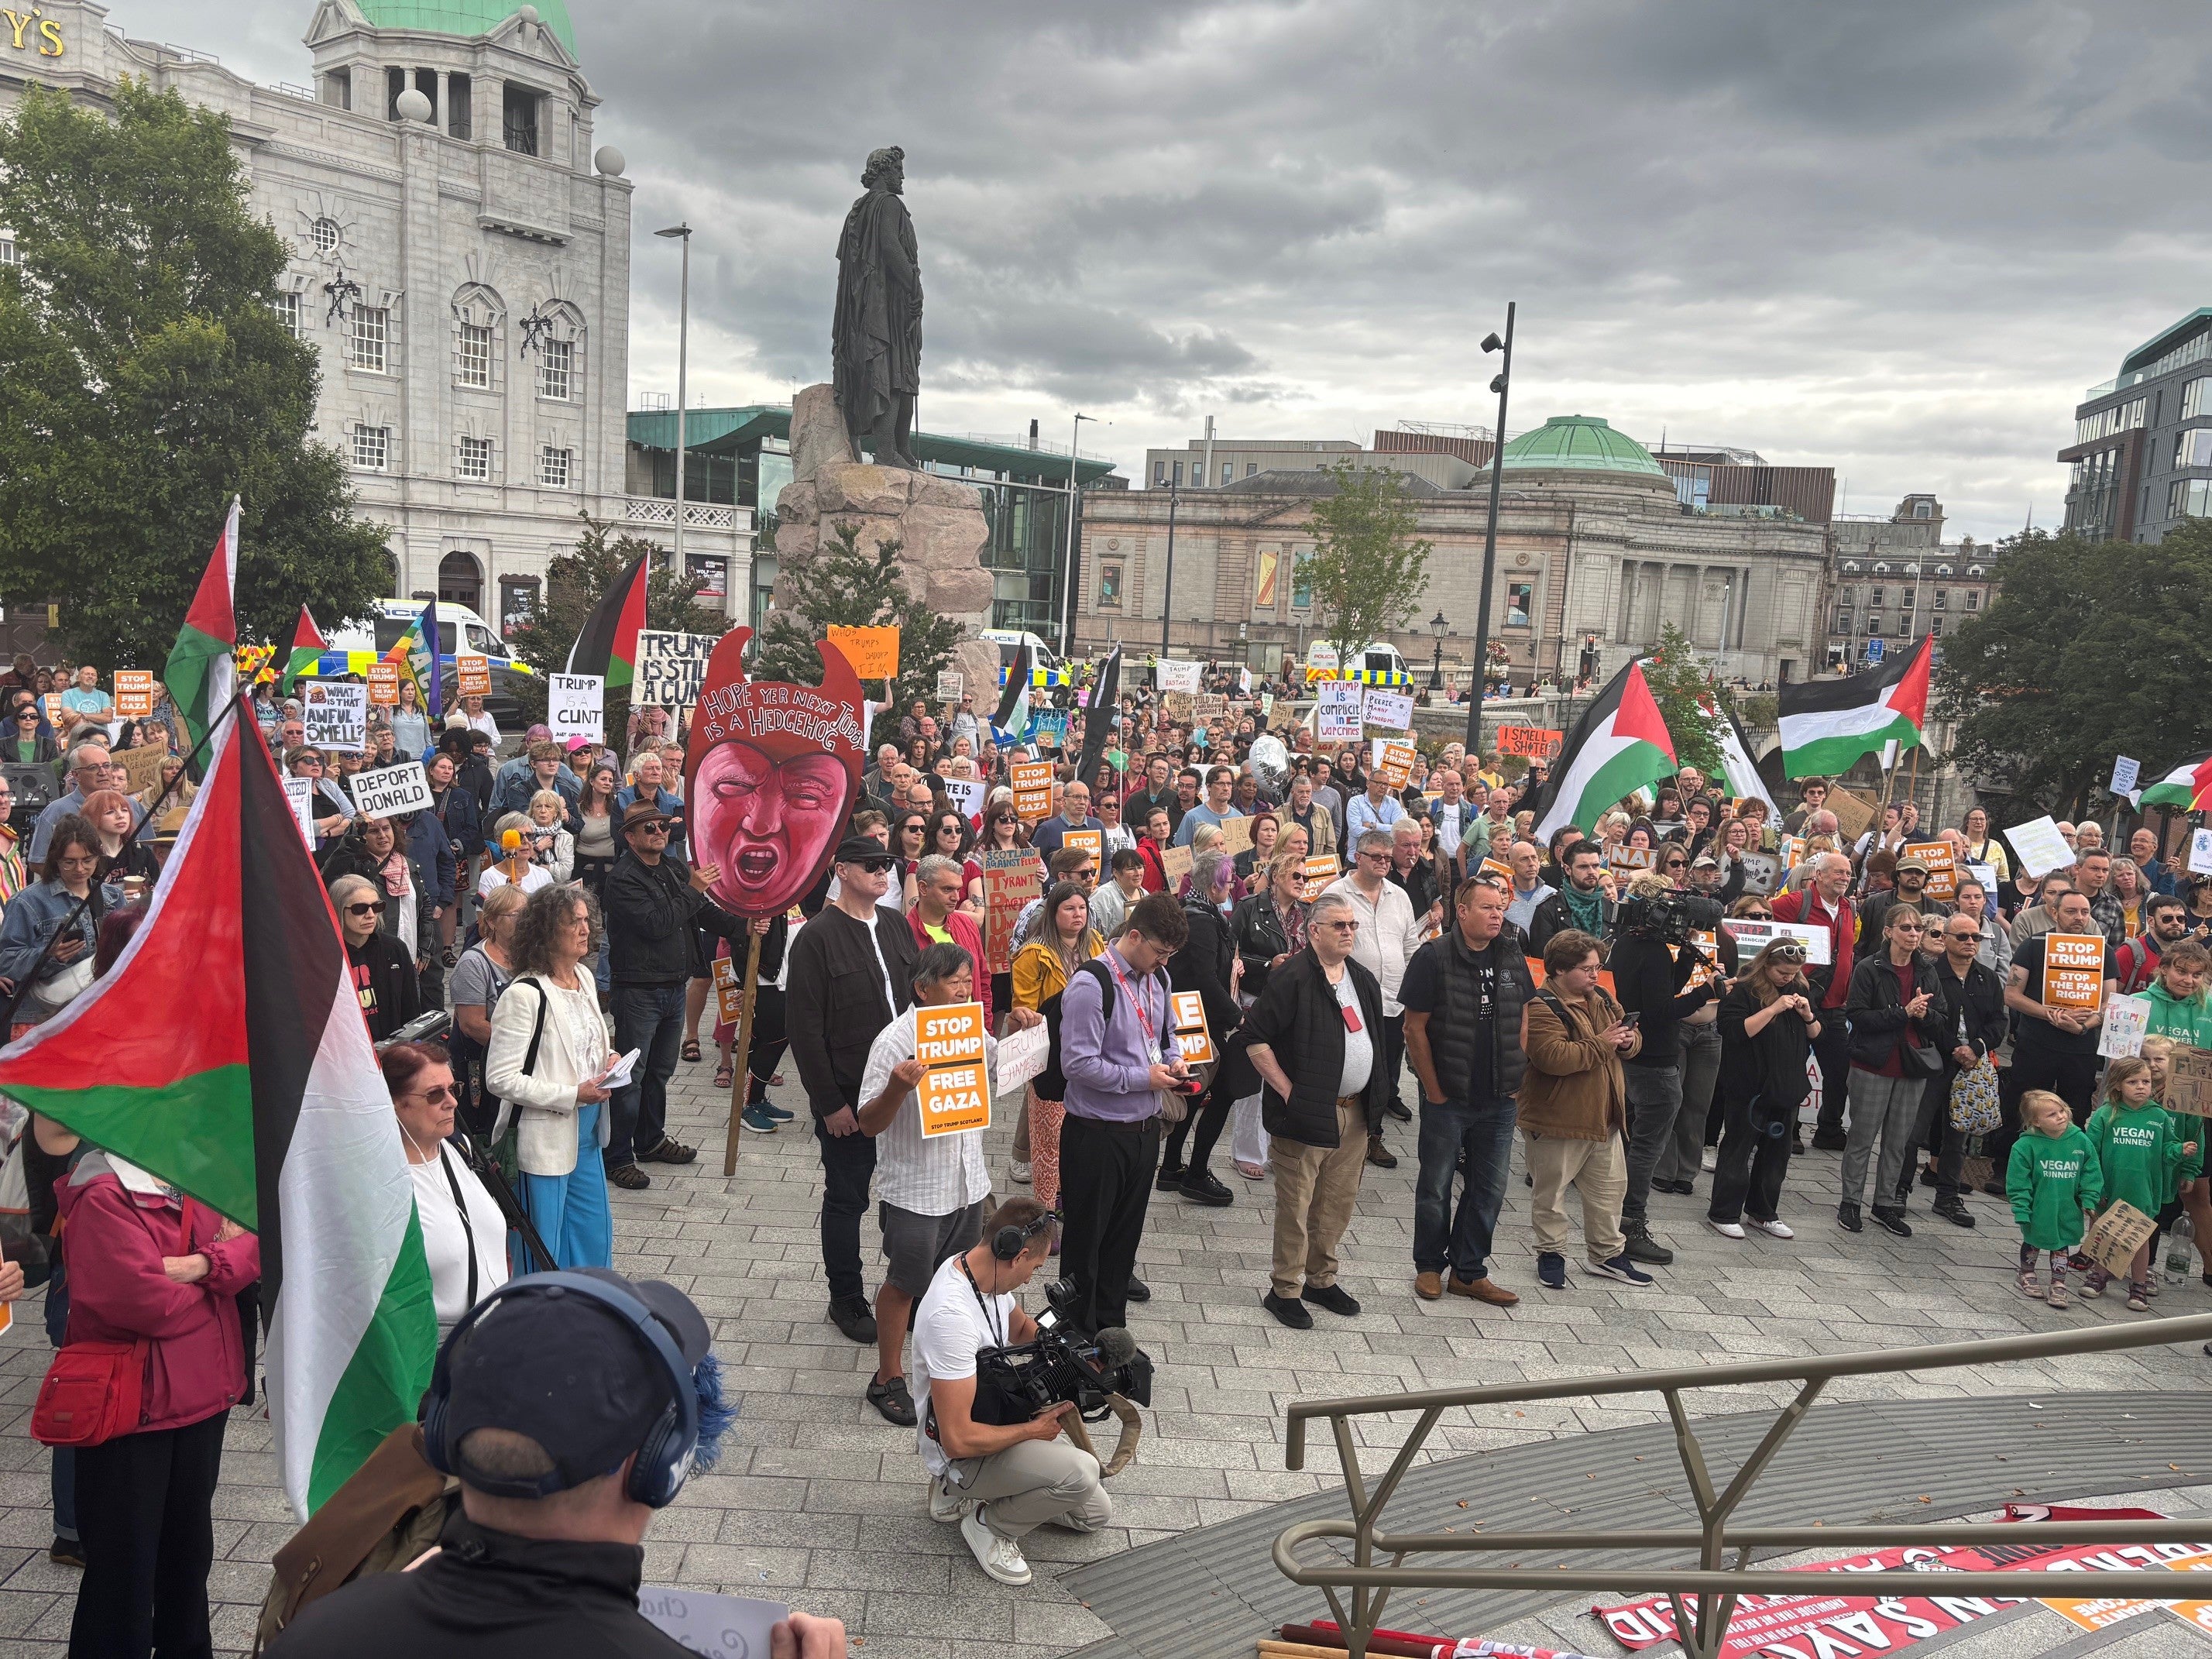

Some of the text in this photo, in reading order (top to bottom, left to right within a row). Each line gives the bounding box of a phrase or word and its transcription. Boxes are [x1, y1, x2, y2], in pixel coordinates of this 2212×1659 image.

[641, 634, 718, 658] TRUMP
[865, 651, 888, 661] DADDY?
[642, 659, 708, 682] IS STIL
[855, 663, 884, 674] TIN
[325, 686, 356, 697] WHAT
[643, 681, 704, 704] A CUN
[337, 698, 361, 707] THAT
[565, 696, 589, 707] IS A
[702, 682, 753, 720] HOPE
[760, 688, 788, 704] YER
[792, 690, 836, 716] NEXT
[1194, 696, 1210, 704] TOLD
[307, 708, 353, 723] AWFUL
[1170, 710, 1192, 719] SCOTLA
[306, 724, 365, 743] SMELL?
[704, 707, 838, 752] IS A HEDGEHOG
[1504, 728, 1547, 742] I SMELL
[1389, 748, 1411, 758] STOP
[1385, 754, 1412, 765] TRUMP
[1018, 768, 1046, 778] STOP
[356, 767, 419, 792] DEPORT
[1014, 778, 1051, 788] TRUMP
[284, 781, 307, 796] NTED
[962, 785, 971, 795] IS
[362, 785, 424, 812] DONALD
[1019, 792, 1046, 802] FREE
[1018, 802, 1048, 812] GAZA
[1070, 837, 1096, 847] STOP
[986, 848, 1036, 860] SCOTLAND
[1612, 846, 1656, 867] NA
[1914, 847, 1945, 857] STOP
[985, 857, 1041, 869] AGAINST FELON
[1927, 858, 1952, 870] UMP
[2056, 942, 2096, 953] STOP
[2049, 953, 2101, 966] TRUMP
[2059, 972, 2090, 981] STOP
[2049, 981, 2098, 991] THE FAR
[2056, 991, 2091, 1000] RIGHT
[926, 1016, 973, 1036] STOP
[2156, 1025, 2200, 1037] VEGAN
[1001, 1021, 1047, 1059] TRUMP
[918, 1036, 981, 1060] TRUMP
[998, 1053, 1036, 1087] SHAMES
[929, 1069, 977, 1091] FREE
[929, 1091, 982, 1114] GAZA
[960, 1118, 983, 1126] SCOTLAND
[2113, 1127, 2155, 1140] VEGAN
[2113, 1137, 2152, 1147] RUNNERS
[2040, 1160, 2079, 1170] VEGAN
[1759, 1614, 1773, 1625] WE
[1773, 1608, 1795, 1624] THAT
[1745, 1618, 1759, 1629] ARE
[1751, 1635, 1766, 1644] THE
[1767, 1633, 1779, 1641] IN
[1727, 1638, 1750, 1650] FULL
